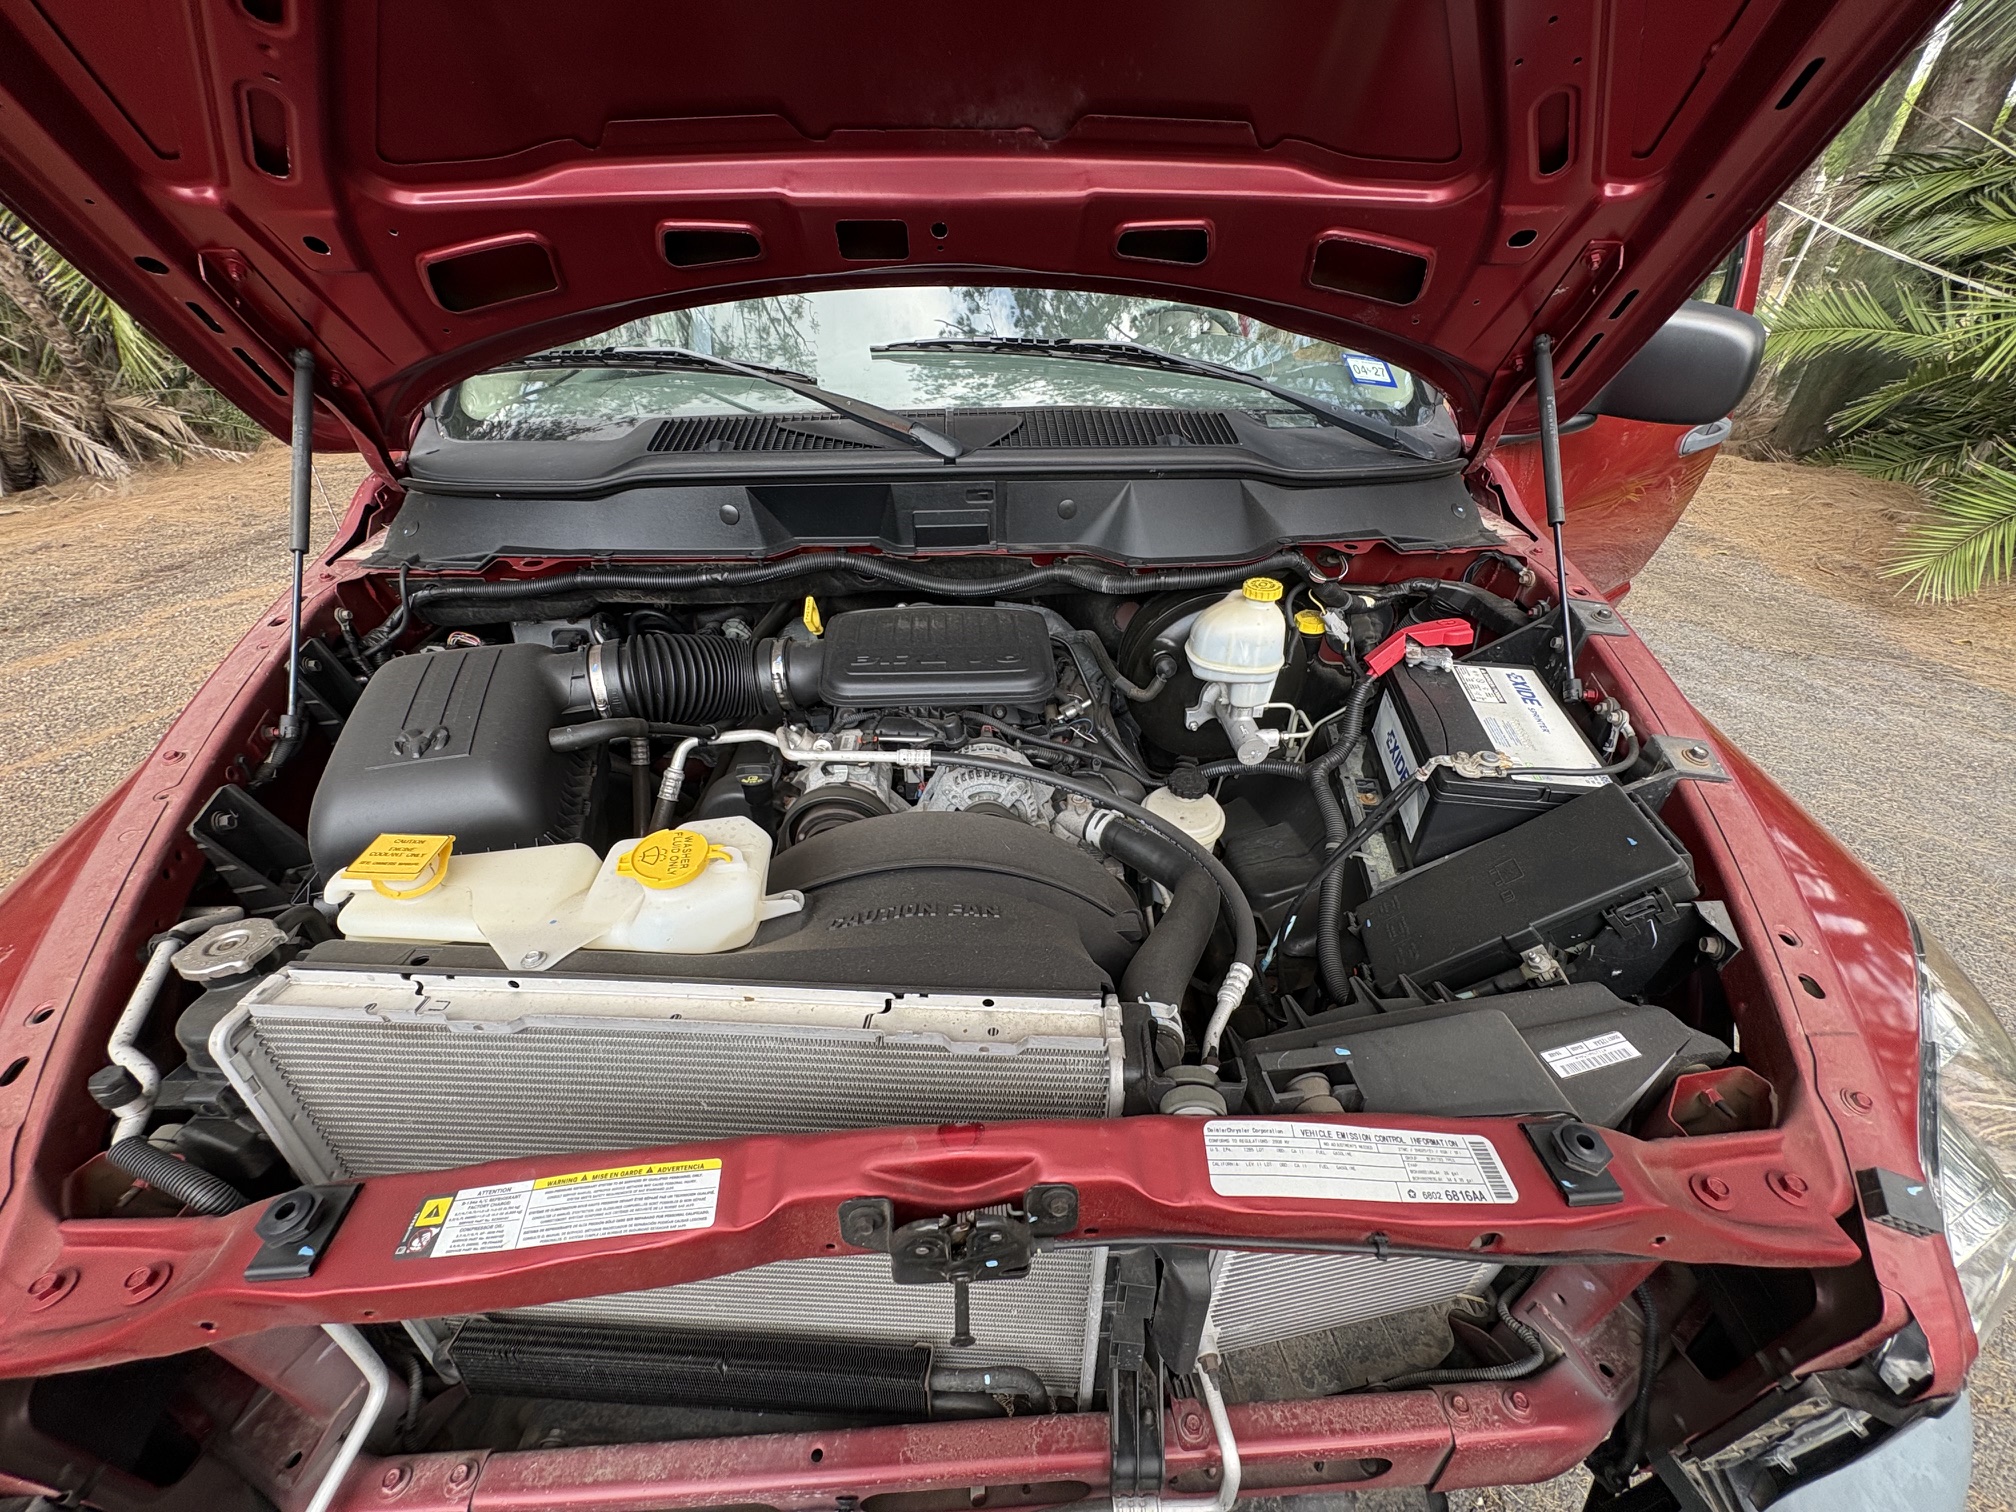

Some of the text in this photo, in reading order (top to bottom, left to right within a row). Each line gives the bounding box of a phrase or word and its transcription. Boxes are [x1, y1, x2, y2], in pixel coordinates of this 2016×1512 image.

[1506, 672, 1541, 709] EXIDE
[1527, 707, 1550, 735] SPRINTER
[667, 831, 680, 876] FLUID ONLY
[679, 836, 694, 870] WASHER
[827, 902, 1002, 931] CAUTION FAN
[1251, 1127, 1283, 1135] Corporation
[1300, 1128, 1458, 1146] VEHICLE EMISSION CONTROL INFORMATION
[657, 1162, 704, 1173] ADVERTENCIA
[546, 1176, 578, 1186] WARNING
[476, 1186, 512, 1196] ATTENTION
[1421, 1189, 1488, 1201] 6802 6816AA
